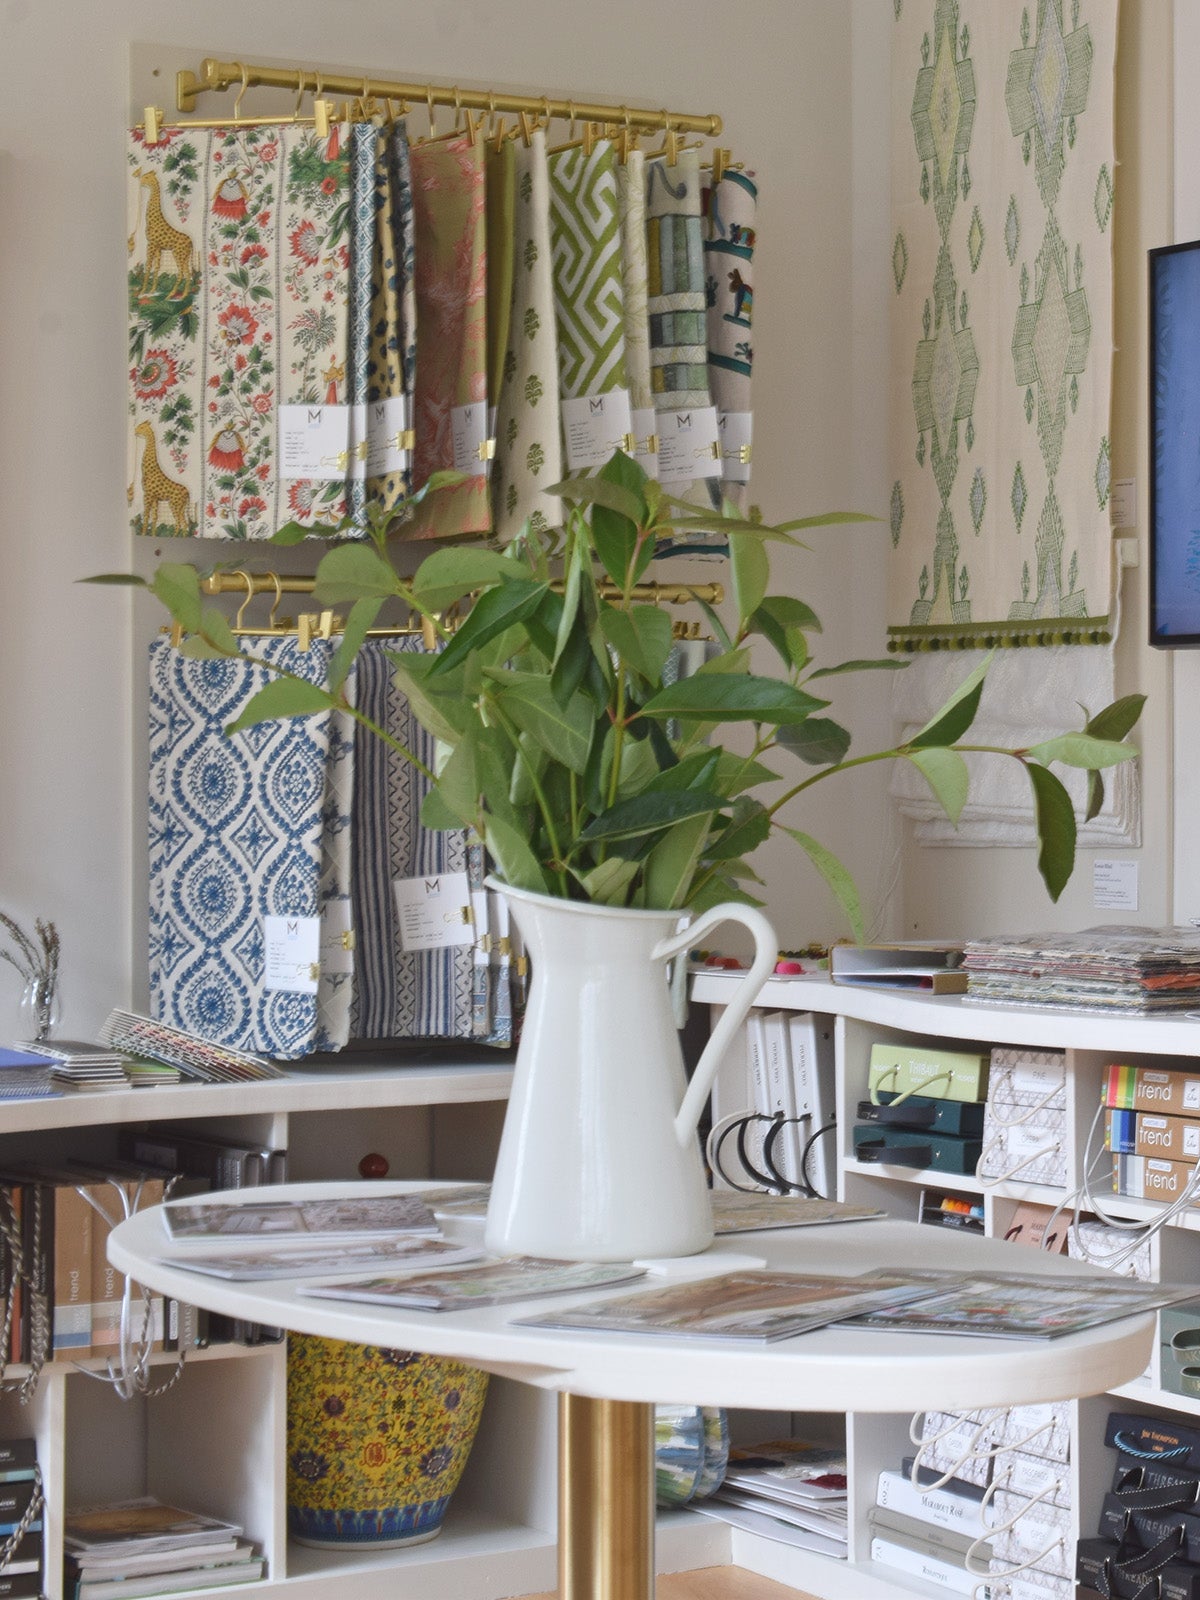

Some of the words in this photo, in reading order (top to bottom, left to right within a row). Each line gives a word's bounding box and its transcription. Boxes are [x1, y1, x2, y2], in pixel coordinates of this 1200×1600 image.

[308, 409, 321, 424] M
[676, 414, 691, 428] M
[425, 878, 440, 893] M
[287, 921, 298, 935] M
[908, 1060, 941, 1077] THIBAUT
[1137, 1081, 1173, 1101] trend
[1138, 1126, 1173, 1147] trend
[1144, 1170, 1178, 1191] trend
[69, 1270, 79, 1301] trend
[104, 1268, 114, 1299] trend
